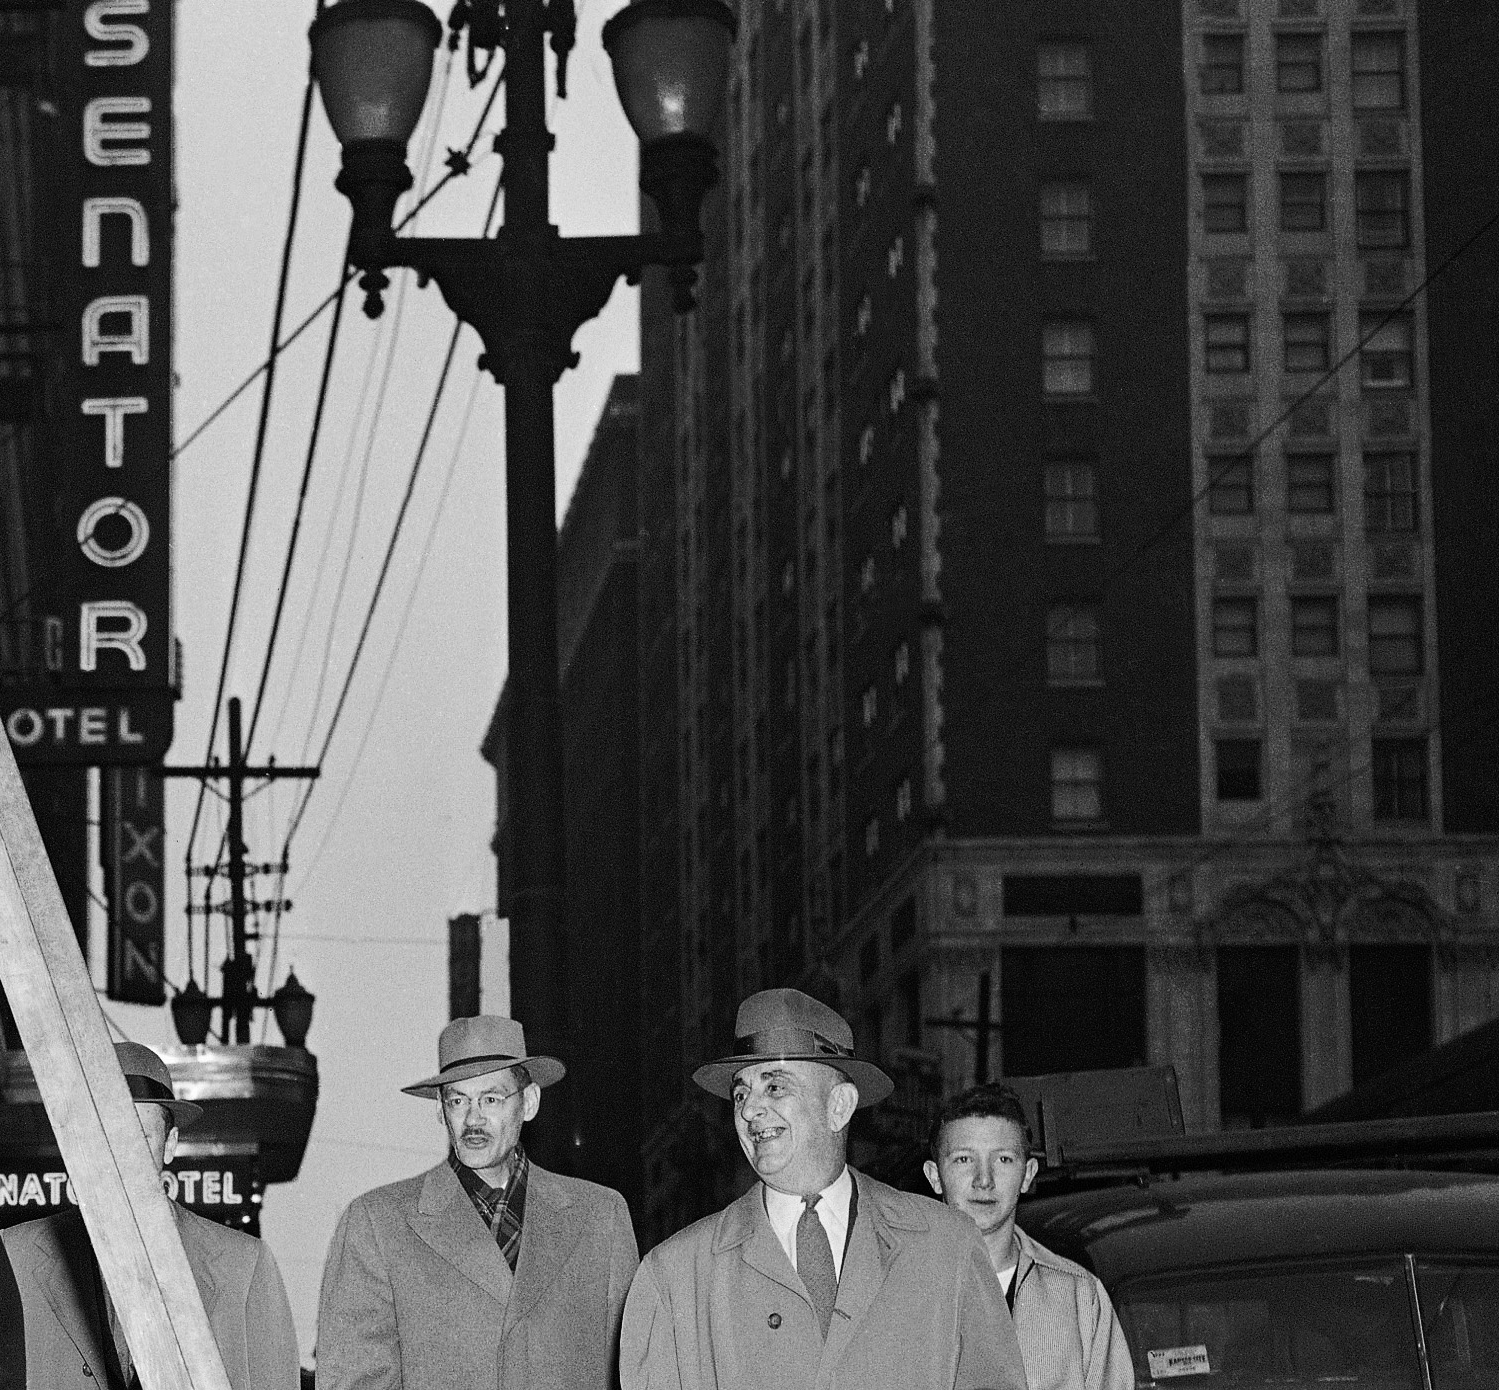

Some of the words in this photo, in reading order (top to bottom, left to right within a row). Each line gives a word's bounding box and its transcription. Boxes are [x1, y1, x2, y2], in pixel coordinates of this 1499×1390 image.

[77, 0, 151, 671] SENATOR
[6, 708, 144, 746] OTEL
[121, 765, 159, 983] IXON
[160, 1170, 243, 1204] OTEL
